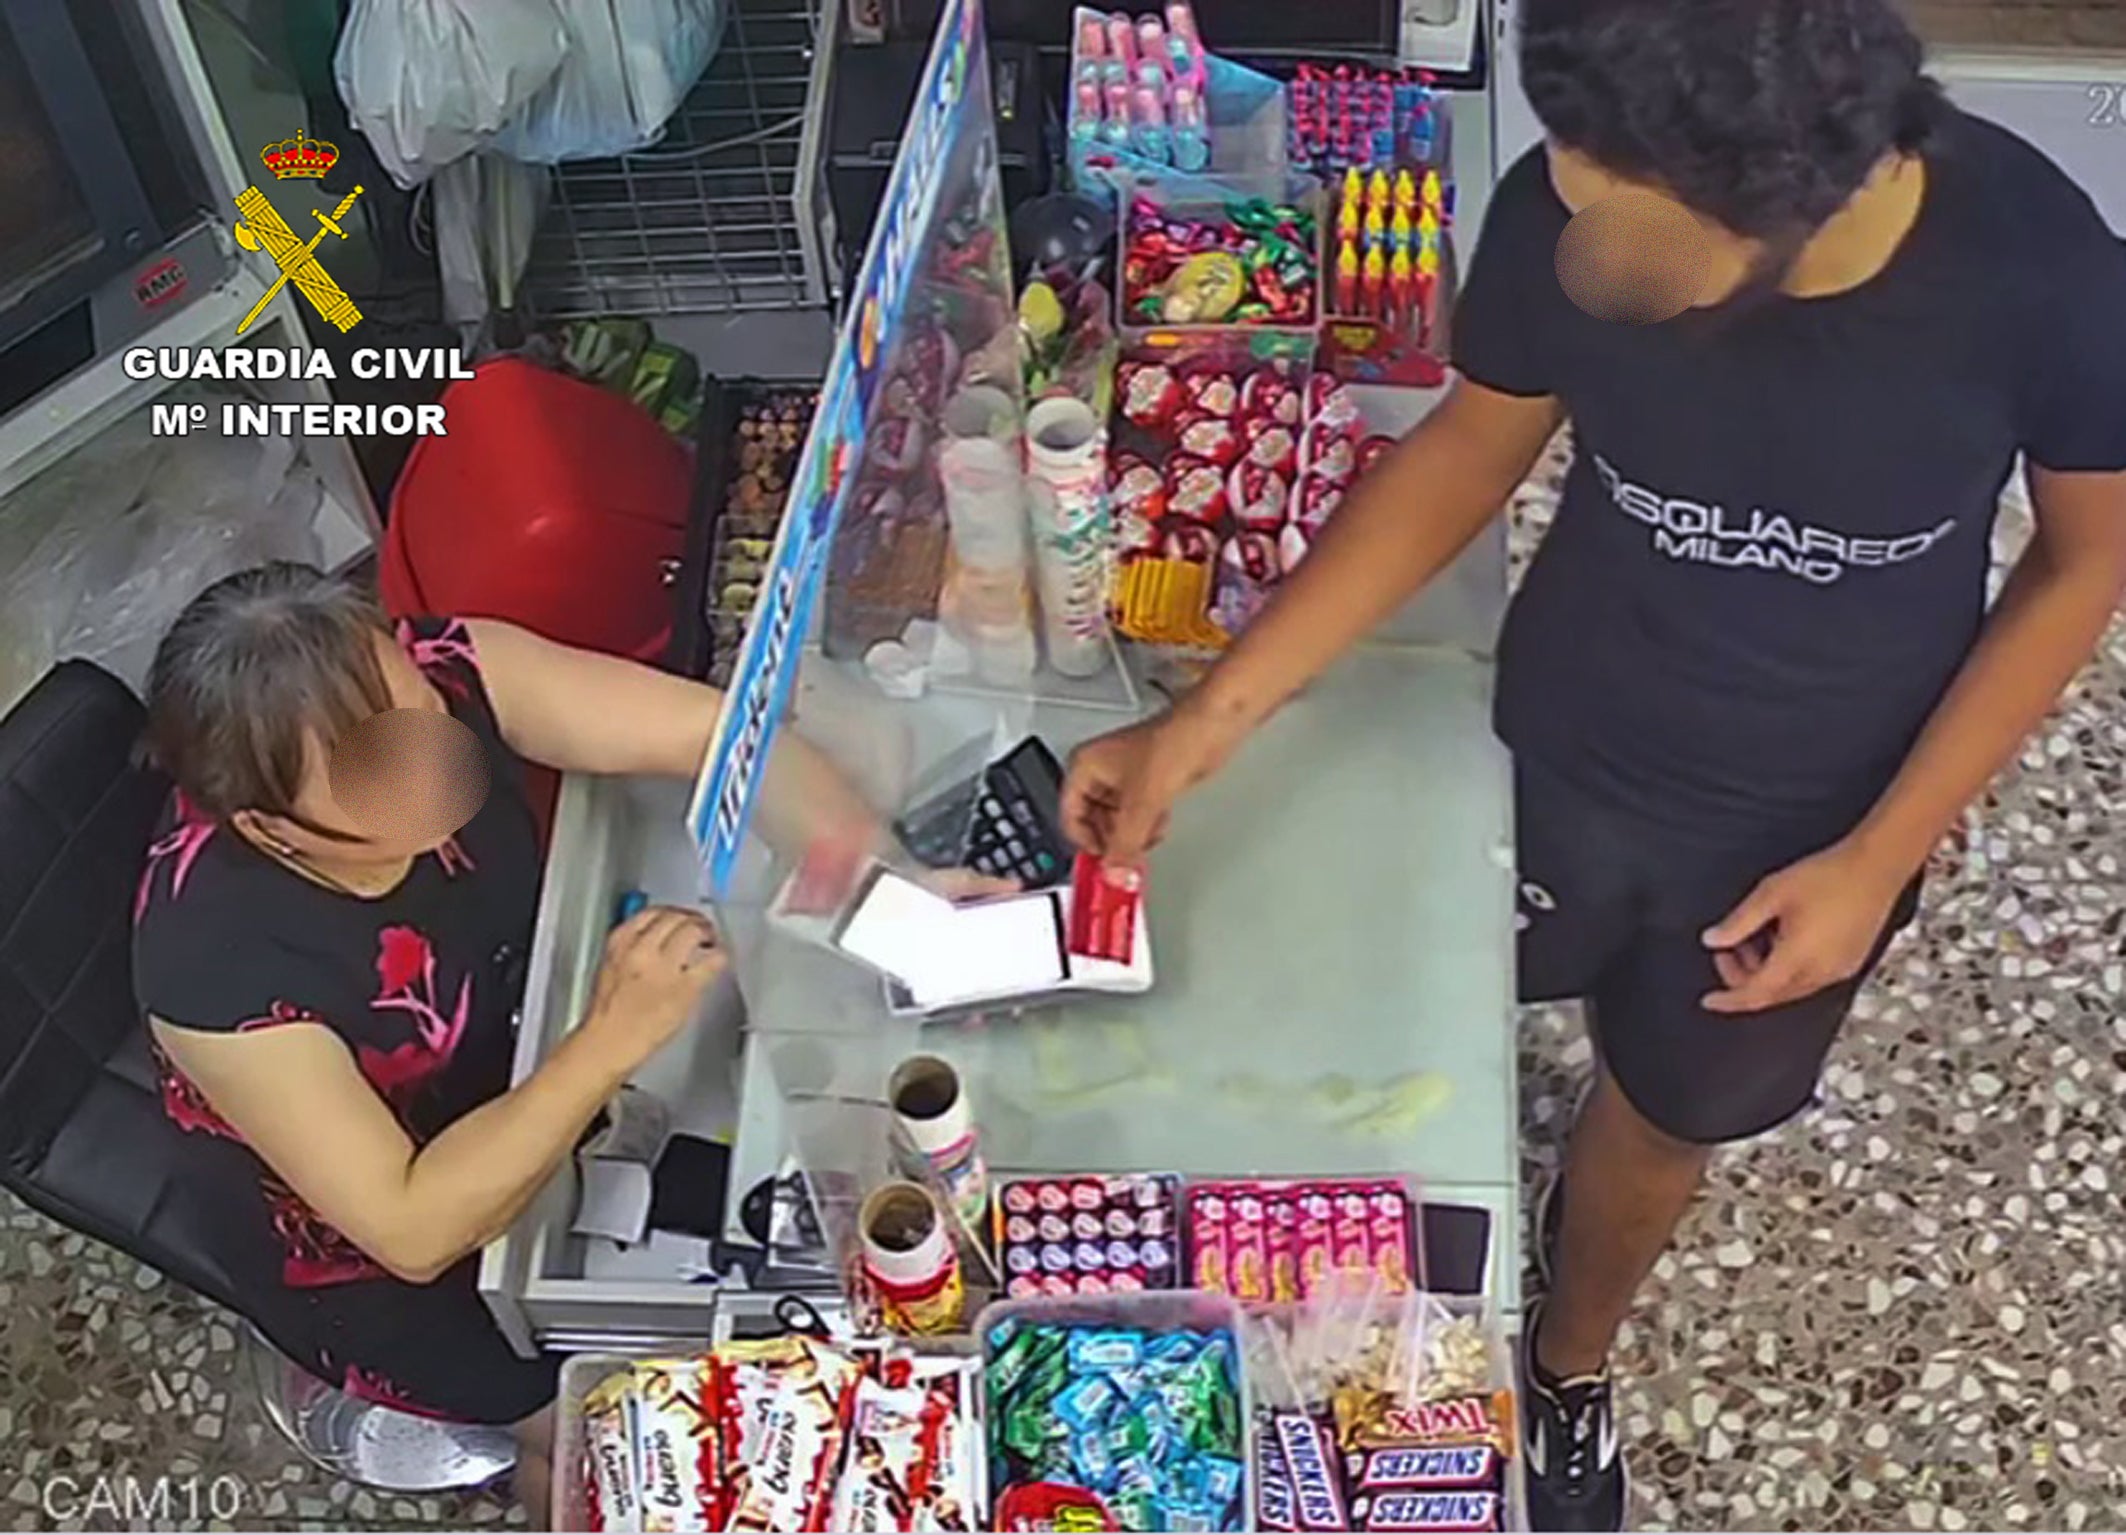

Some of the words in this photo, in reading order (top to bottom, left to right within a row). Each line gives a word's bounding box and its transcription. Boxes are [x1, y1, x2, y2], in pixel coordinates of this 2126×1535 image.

[1655, 528, 1842, 583] MILANO
[653, 1428, 683, 1508] bueno
[761, 1410, 797, 1495] bueno
[1282, 1419, 1337, 1523] SNICKERS
[1371, 1449, 1483, 1478] SNICKERS
[1372, 1496, 1487, 1524] SNICKERS
